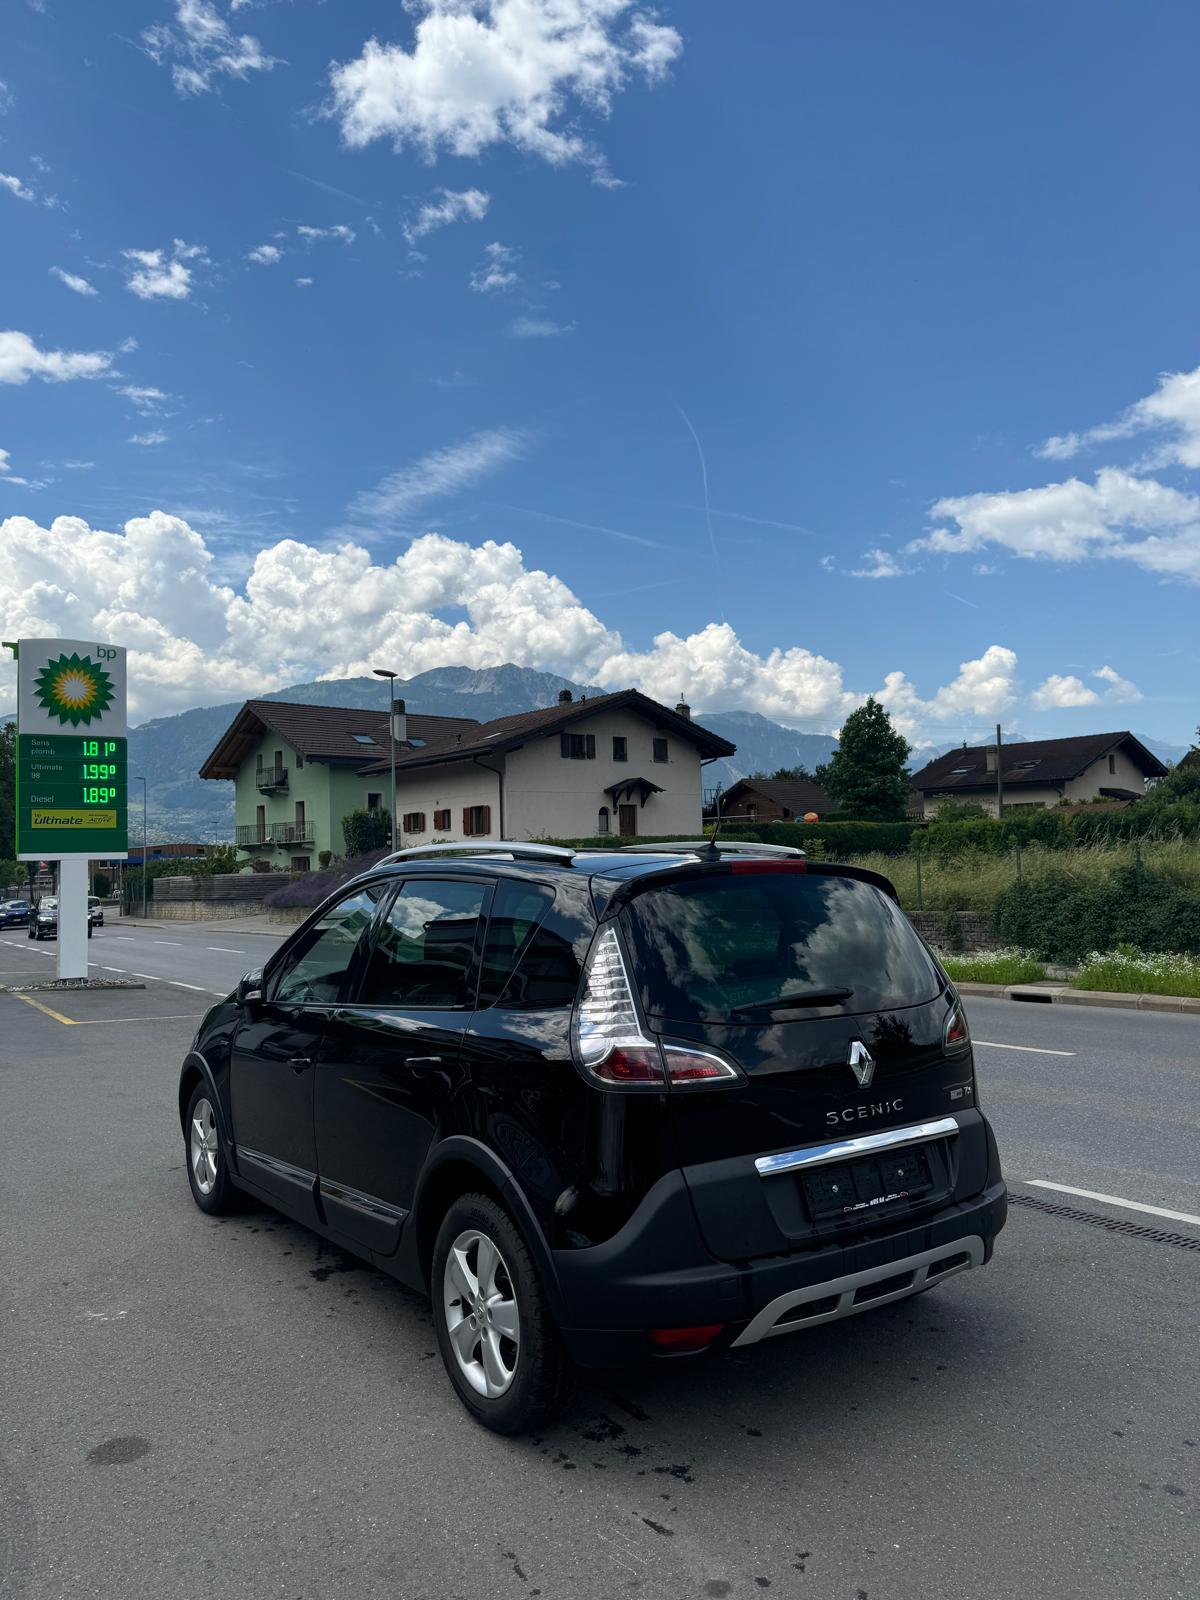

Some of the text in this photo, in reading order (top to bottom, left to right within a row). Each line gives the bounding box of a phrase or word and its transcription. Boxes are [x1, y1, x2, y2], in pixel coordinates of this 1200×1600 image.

[97, 646, 117, 662] bp
[31, 748, 55, 756] plomb
[31, 763, 62, 771] Ultimate
[31, 795, 54, 803] Diesel
[34, 816, 83, 825] ultimate
[826, 1098, 904, 1125] SCENIC
